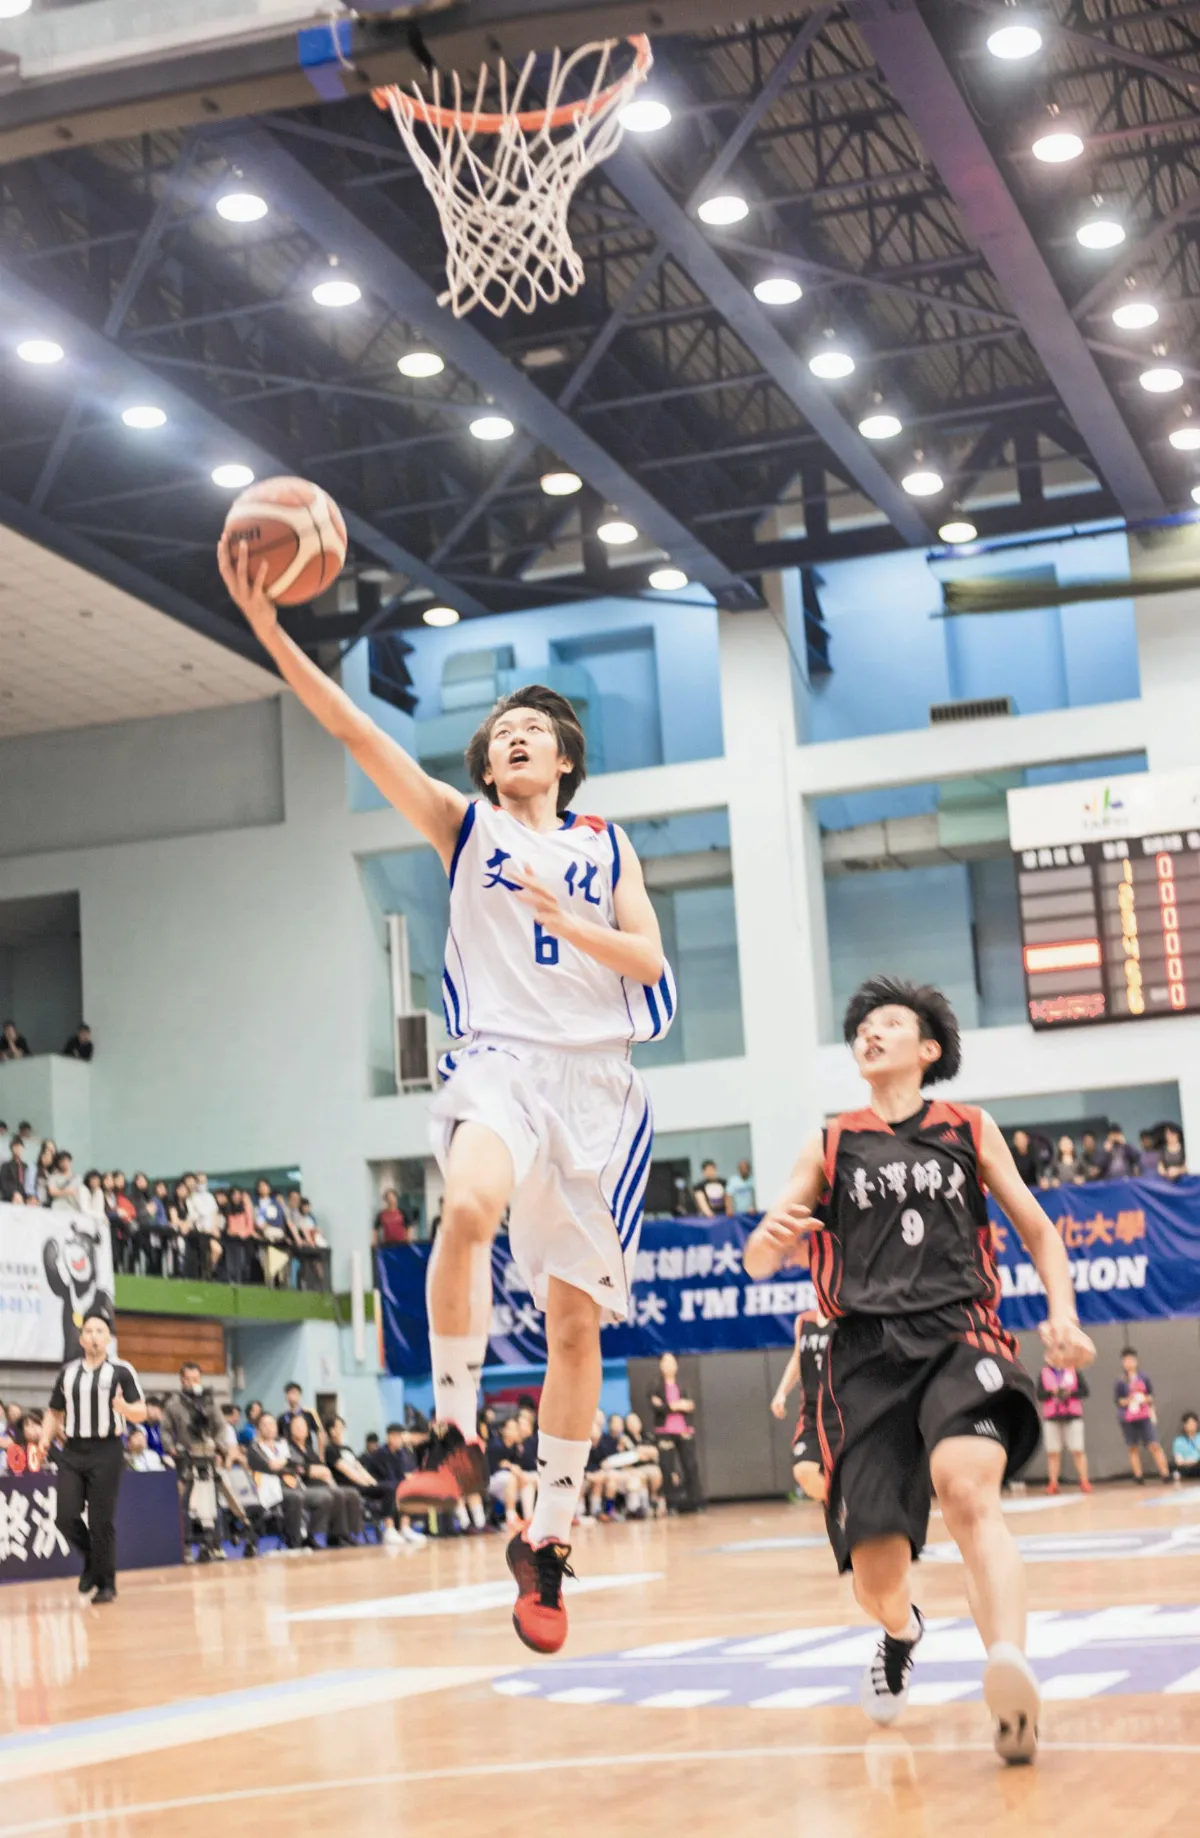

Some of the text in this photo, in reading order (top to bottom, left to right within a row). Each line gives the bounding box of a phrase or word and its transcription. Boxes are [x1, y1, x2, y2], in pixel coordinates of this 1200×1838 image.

[482, 848, 600, 905] 文化
[533, 918, 559, 965] 6
[901, 1208, 925, 1246] 9
[1022, 1209, 1146, 1251] 化大學
[678, 1285, 740, 1322] I'M
[997, 1255, 1149, 1297] AMION
